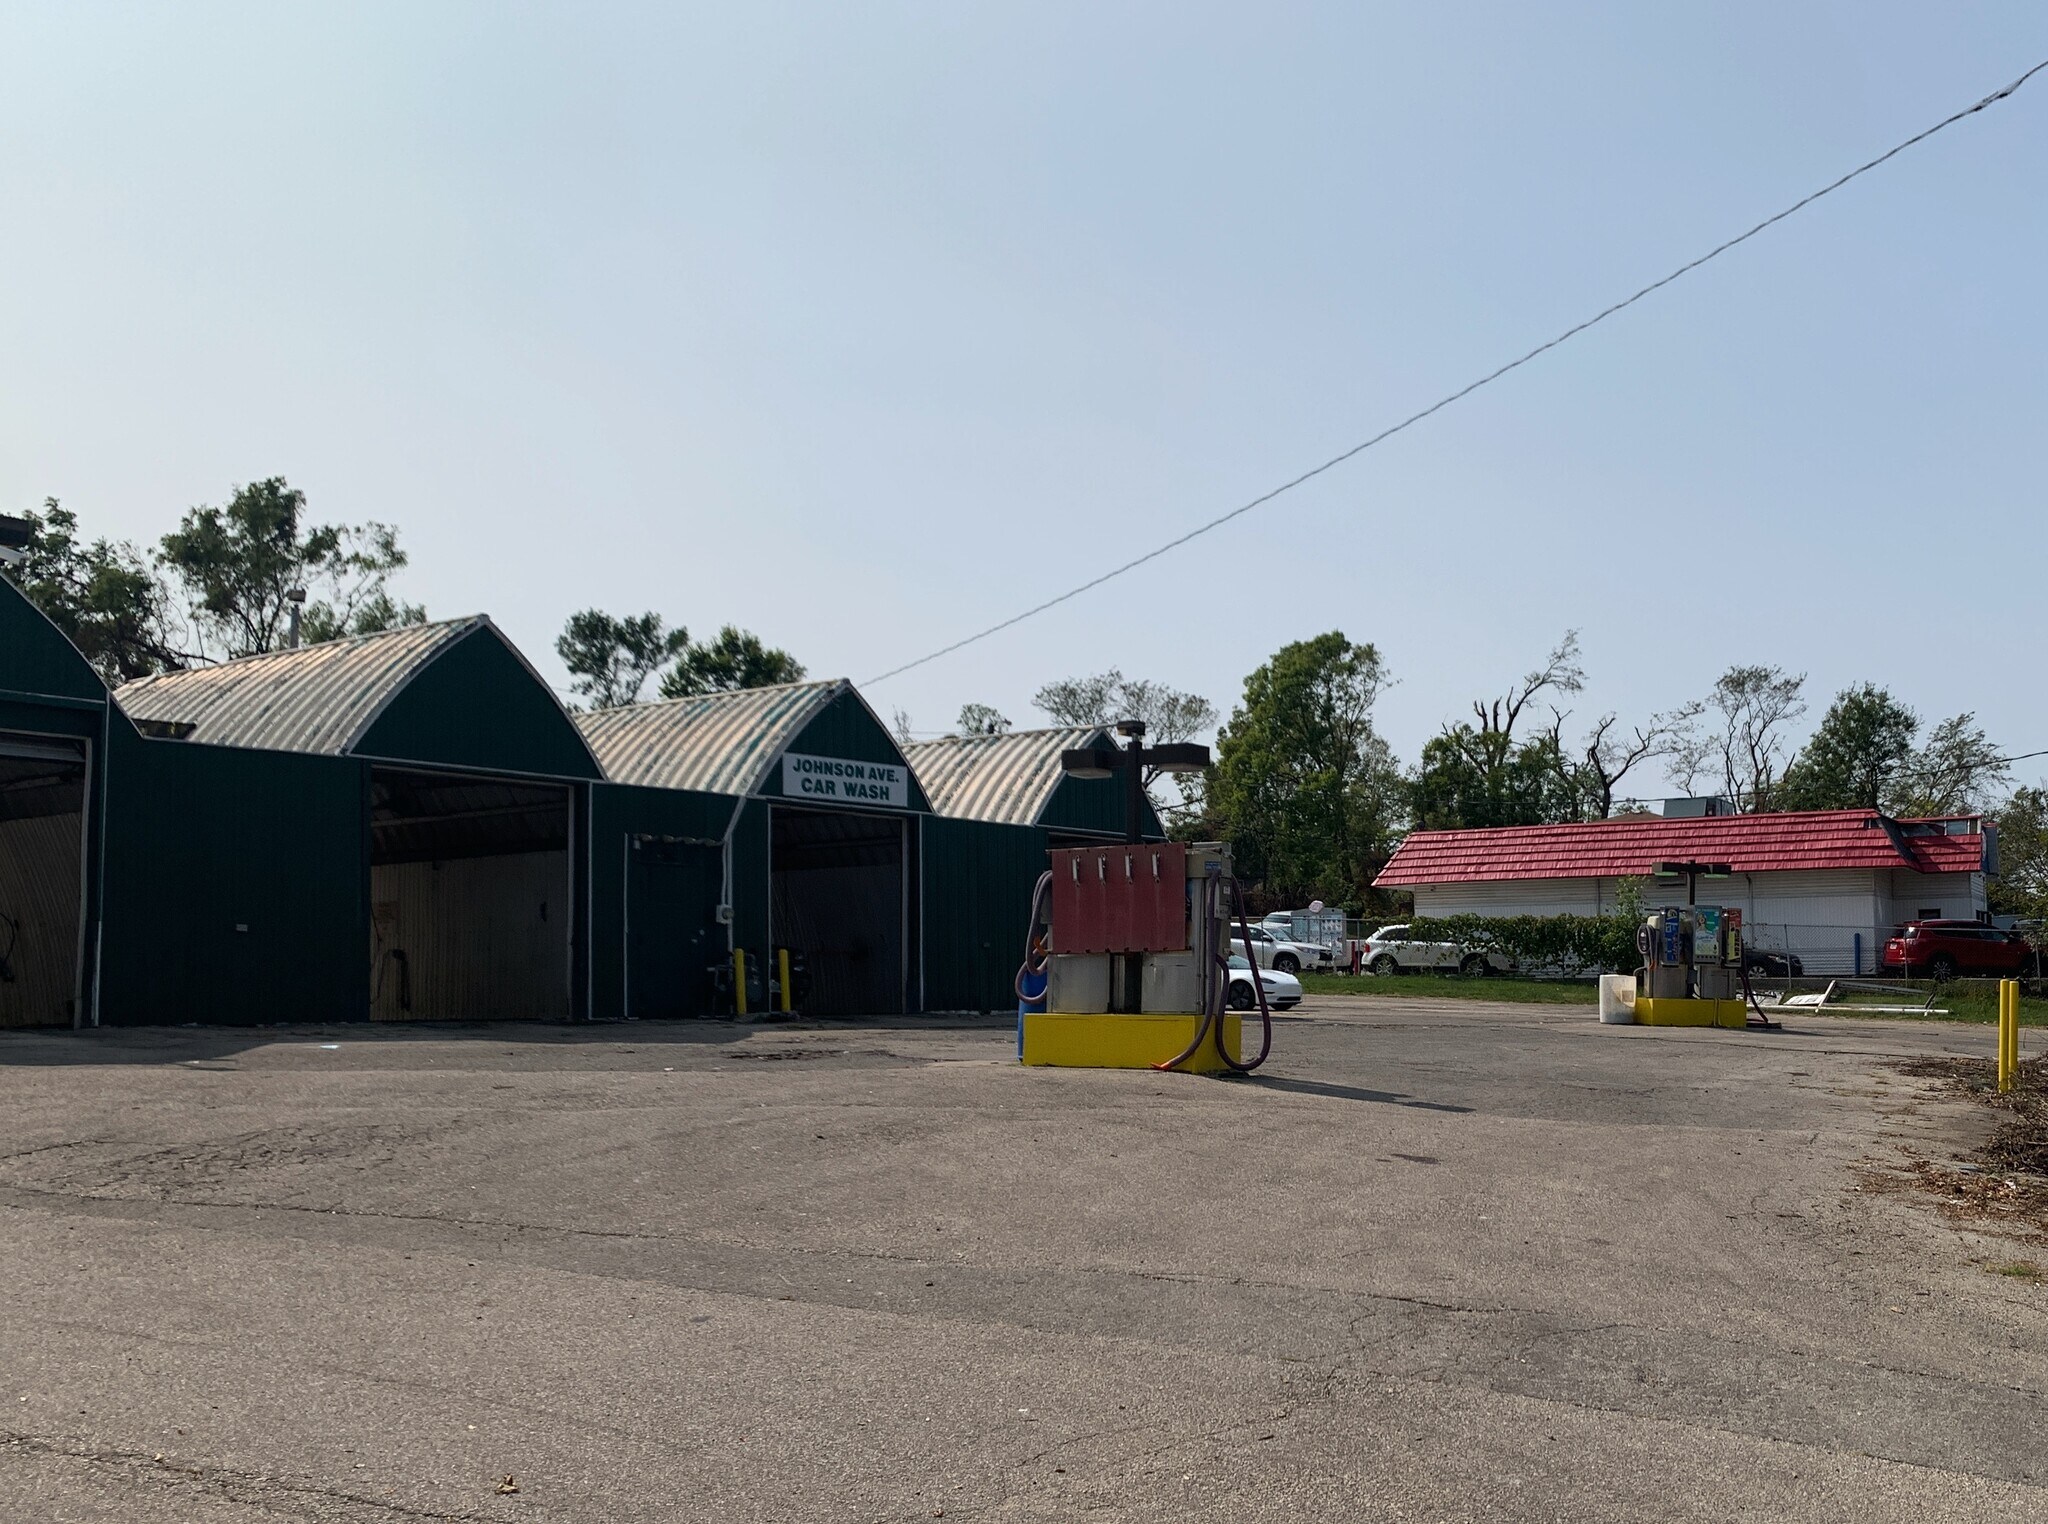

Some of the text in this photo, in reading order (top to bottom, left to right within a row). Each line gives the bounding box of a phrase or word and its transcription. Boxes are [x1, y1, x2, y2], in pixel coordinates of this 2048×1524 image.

[793, 758, 900, 783] JOHNSON AVE.
[801, 778, 890, 801] CAR WASH
